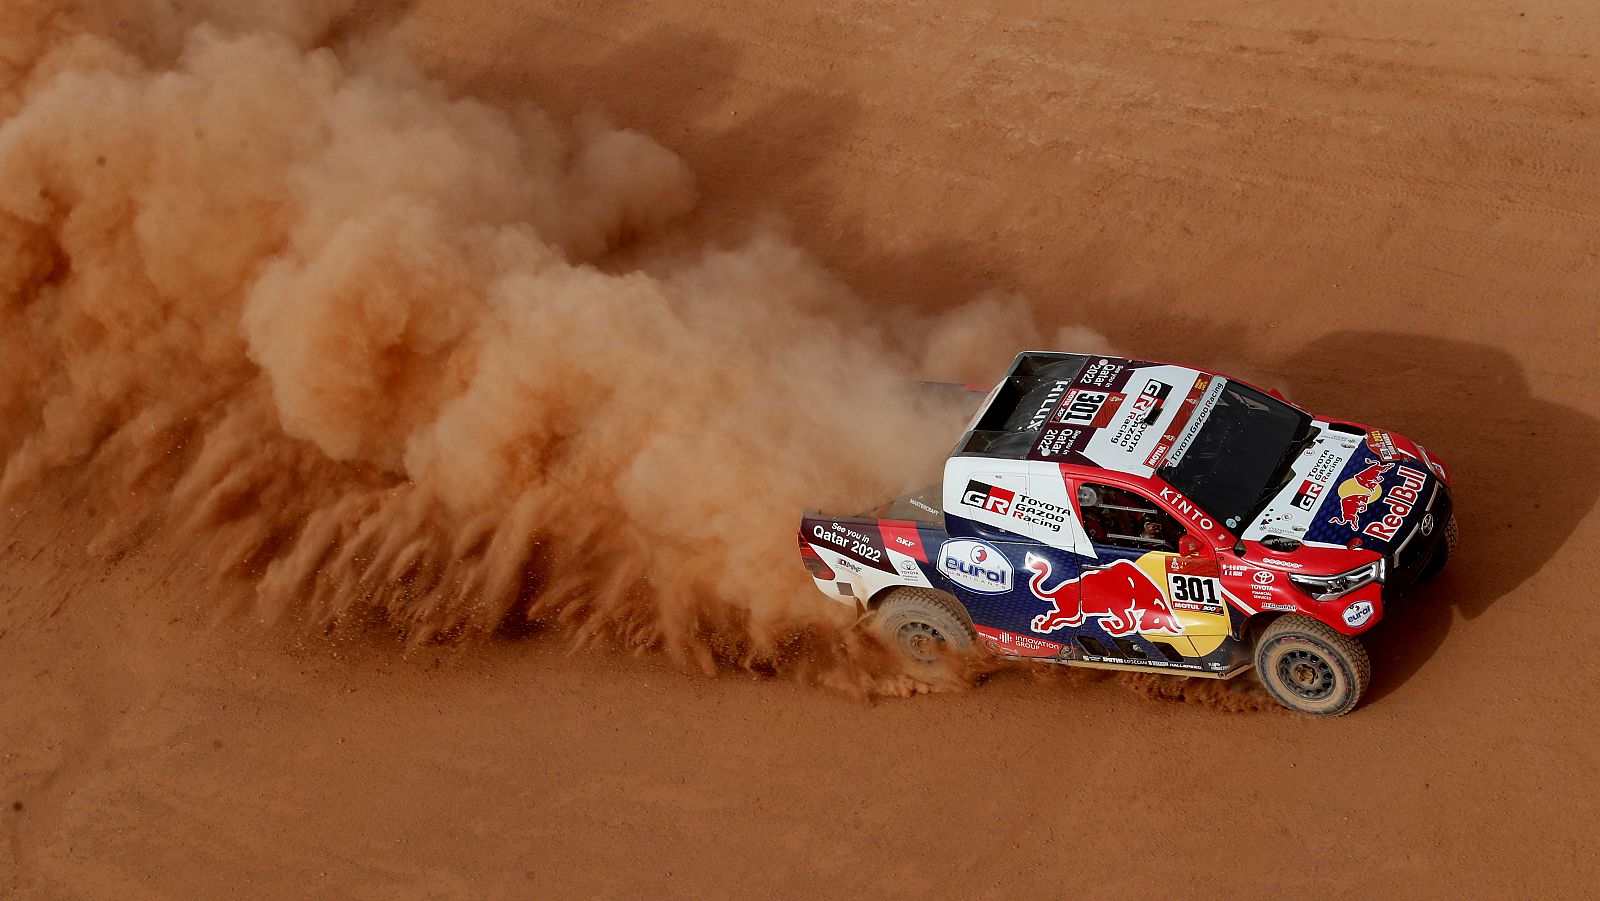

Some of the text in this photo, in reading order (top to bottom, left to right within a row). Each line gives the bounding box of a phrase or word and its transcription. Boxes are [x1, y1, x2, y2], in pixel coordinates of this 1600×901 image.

[1080, 364, 1100, 384] 2022
[1094, 364, 1116, 386] Qatar
[1027, 380, 1068, 432] HILUX
[1064, 393, 1105, 420] 301
[1135, 380, 1162, 411] GR
[1110, 412, 1136, 444] Racing
[1171, 432, 1192, 461] TOYOTA
[1191, 410, 1208, 432] GAZOO
[1206, 382, 1224, 409] Racing
[1037, 429, 1058, 452] 2022
[1050, 428, 1073, 454] Qatar
[1148, 445, 1166, 466] MOTUL
[1308, 450, 1330, 478] TOYOTA
[1315, 454, 1335, 480] GAZOO
[1322, 457, 1342, 482] Racing
[962, 490, 1010, 514] GR
[1019, 494, 1071, 516] TOYOTA
[1300, 484, 1324, 510] GR
[1012, 510, 1061, 532] Racing
[1015, 503, 1065, 523] GAZOO
[813, 525, 882, 562] Qatar 2022
[832, 522, 870, 544] See you in
[896, 536, 916, 548] SKF
[946, 556, 1006, 584] eurol
[1172, 576, 1220, 604] 301
[1347, 606, 1372, 624] eurol
[1016, 635, 1060, 650] INNOVATION
[1016, 641, 1040, 650] GROUP
